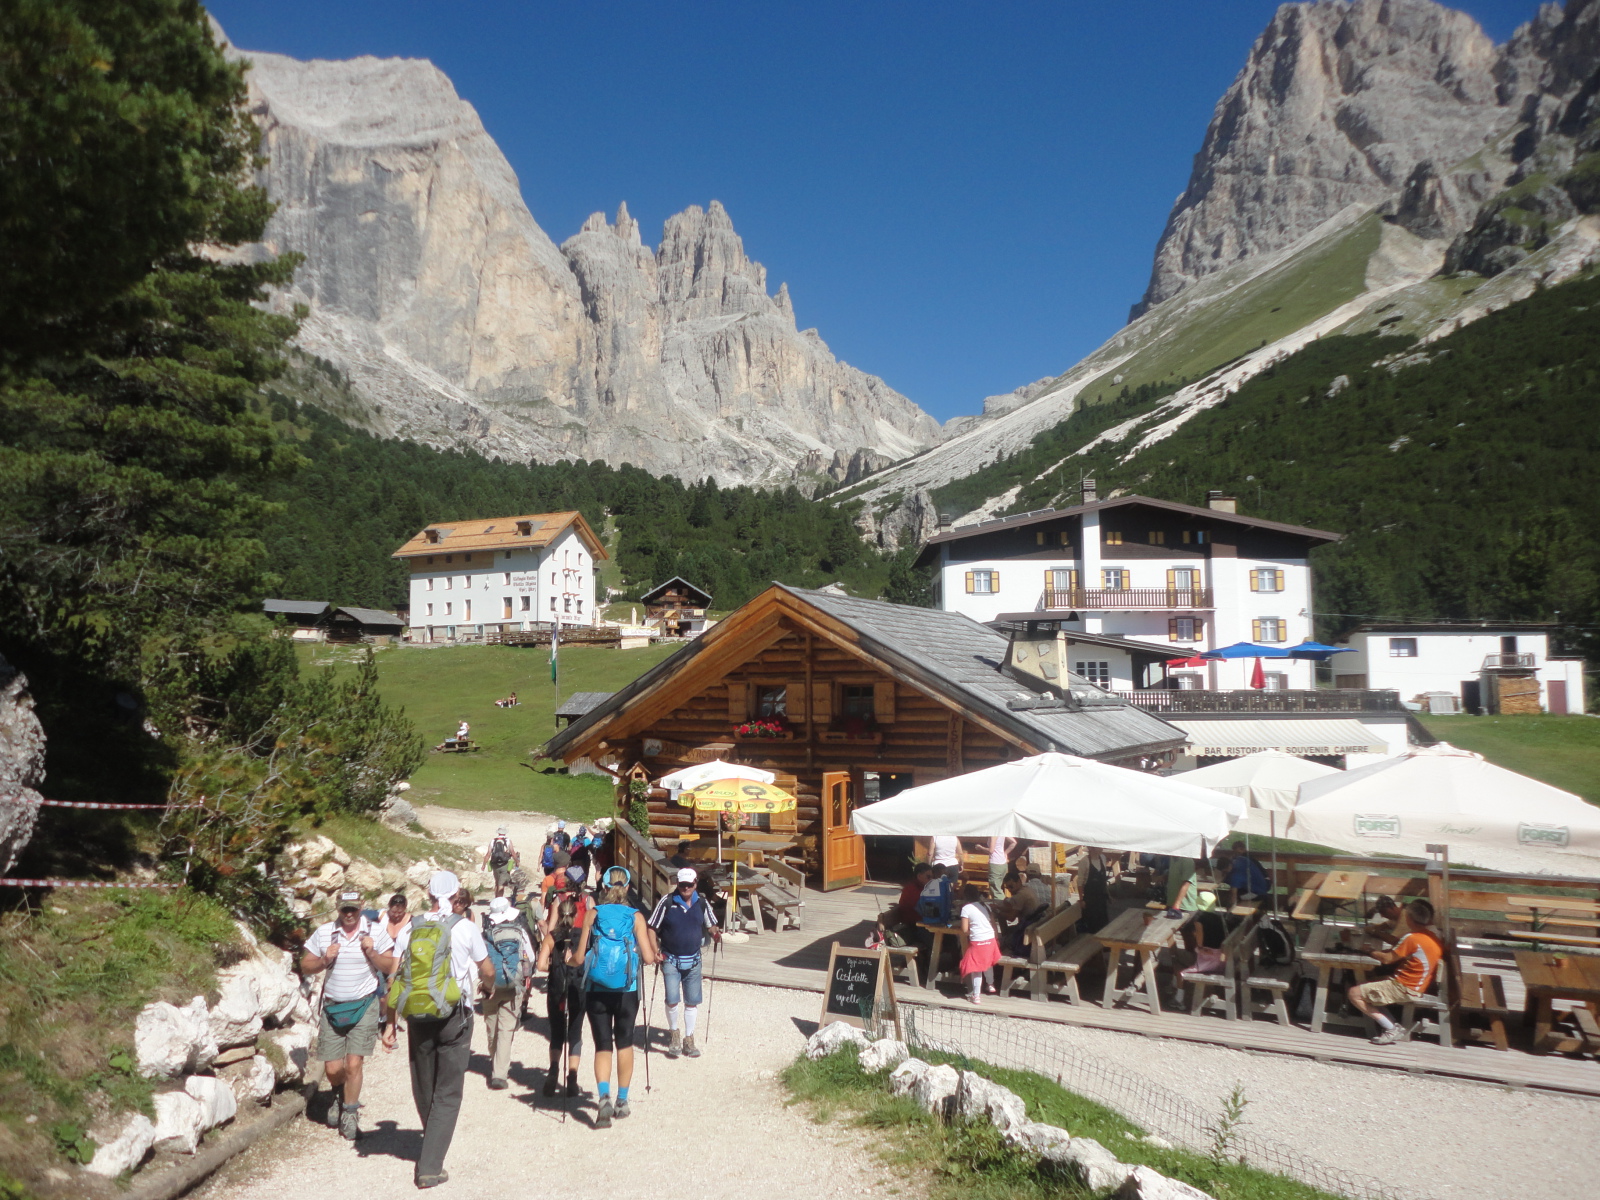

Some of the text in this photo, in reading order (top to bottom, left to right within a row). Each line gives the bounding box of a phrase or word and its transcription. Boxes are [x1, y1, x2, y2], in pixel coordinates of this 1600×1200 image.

[1204, 747, 1222, 755] BAR
[1285, 746, 1330, 754] SOUVENIR
[1333, 746, 1369, 754] CAMERE
[1357, 820, 1398, 832] FORST
[1521, 829, 1566, 841] FORST
